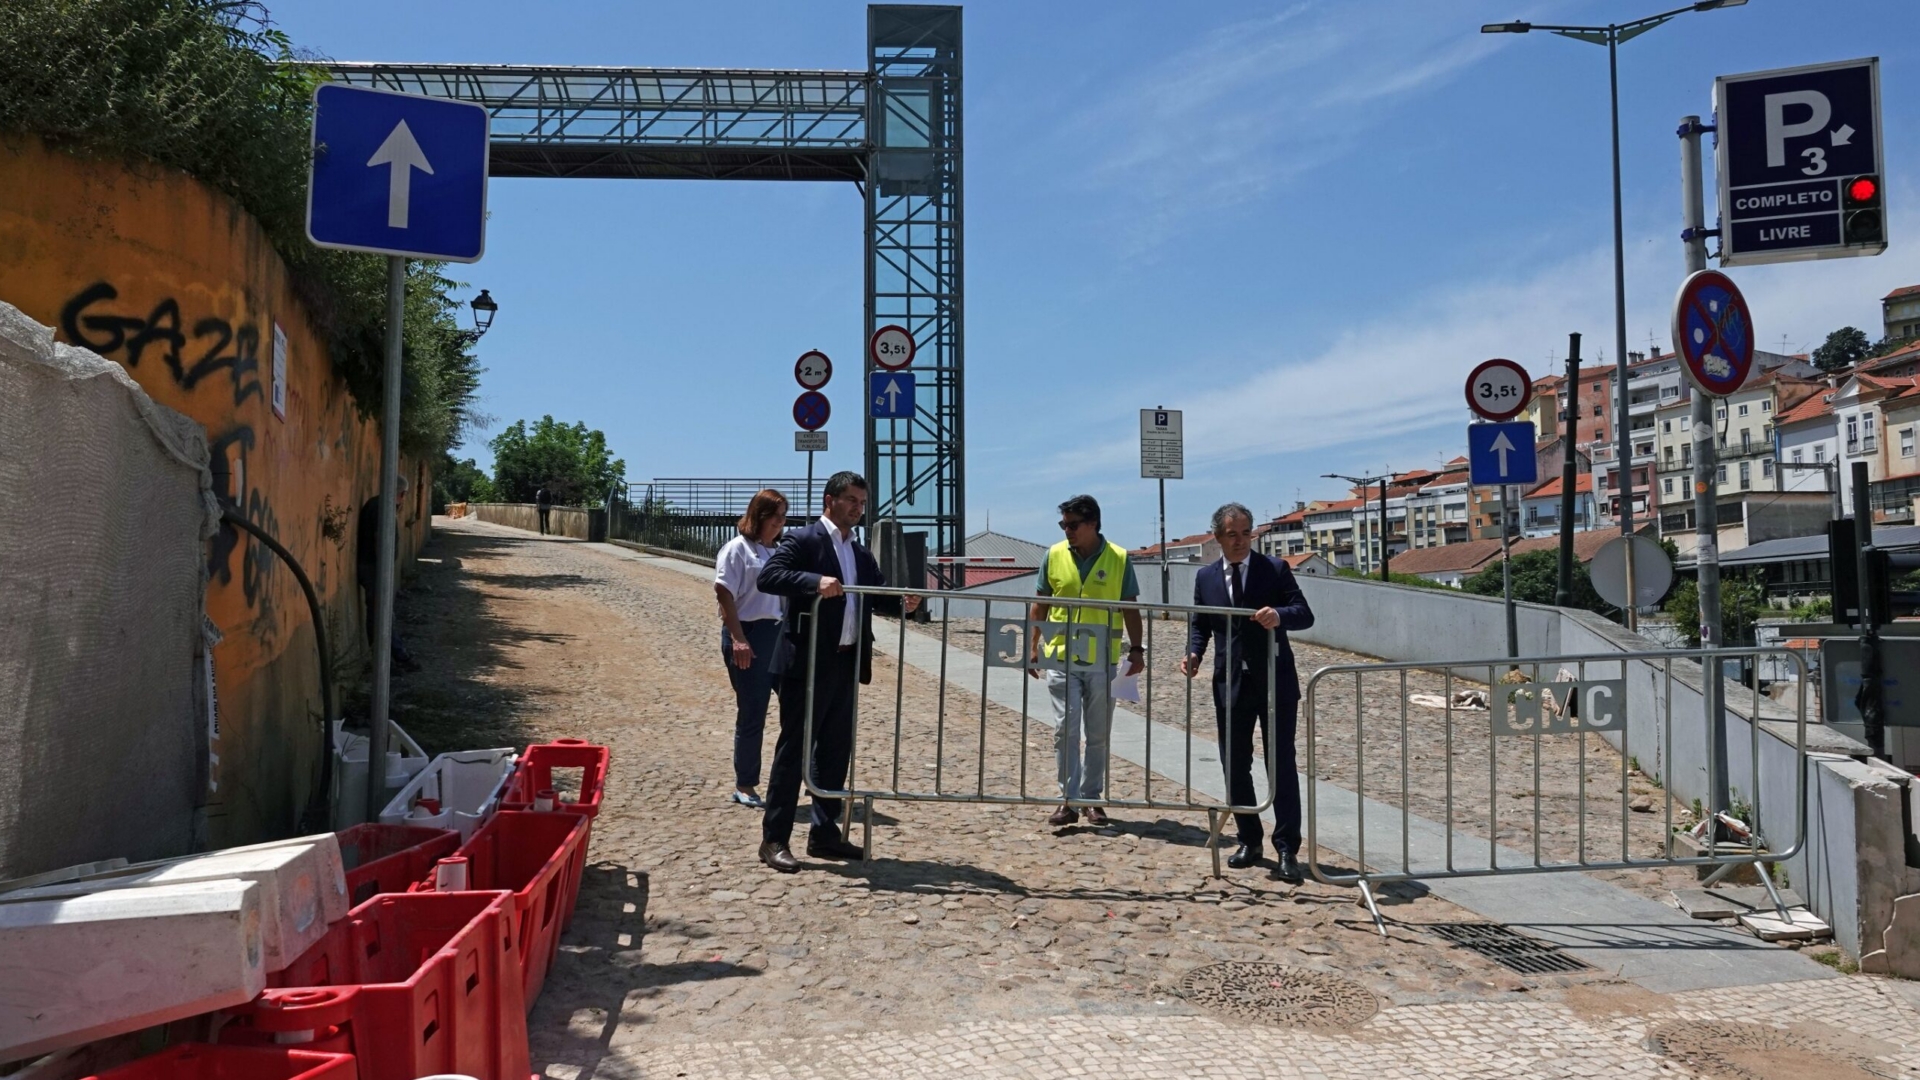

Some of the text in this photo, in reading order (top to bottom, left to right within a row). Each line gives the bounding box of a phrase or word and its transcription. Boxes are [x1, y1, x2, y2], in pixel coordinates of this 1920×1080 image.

[1764, 90, 1832, 176] P 3
[1735, 189, 1833, 211] COMPLETO
[1759, 225, 1811, 242] LIVRE
[880, 341, 906, 357] 3,5t
[804, 367, 812, 376] 2
[1479, 382, 1517, 401] 3,5t
[1507, 685, 1612, 731] CMC
